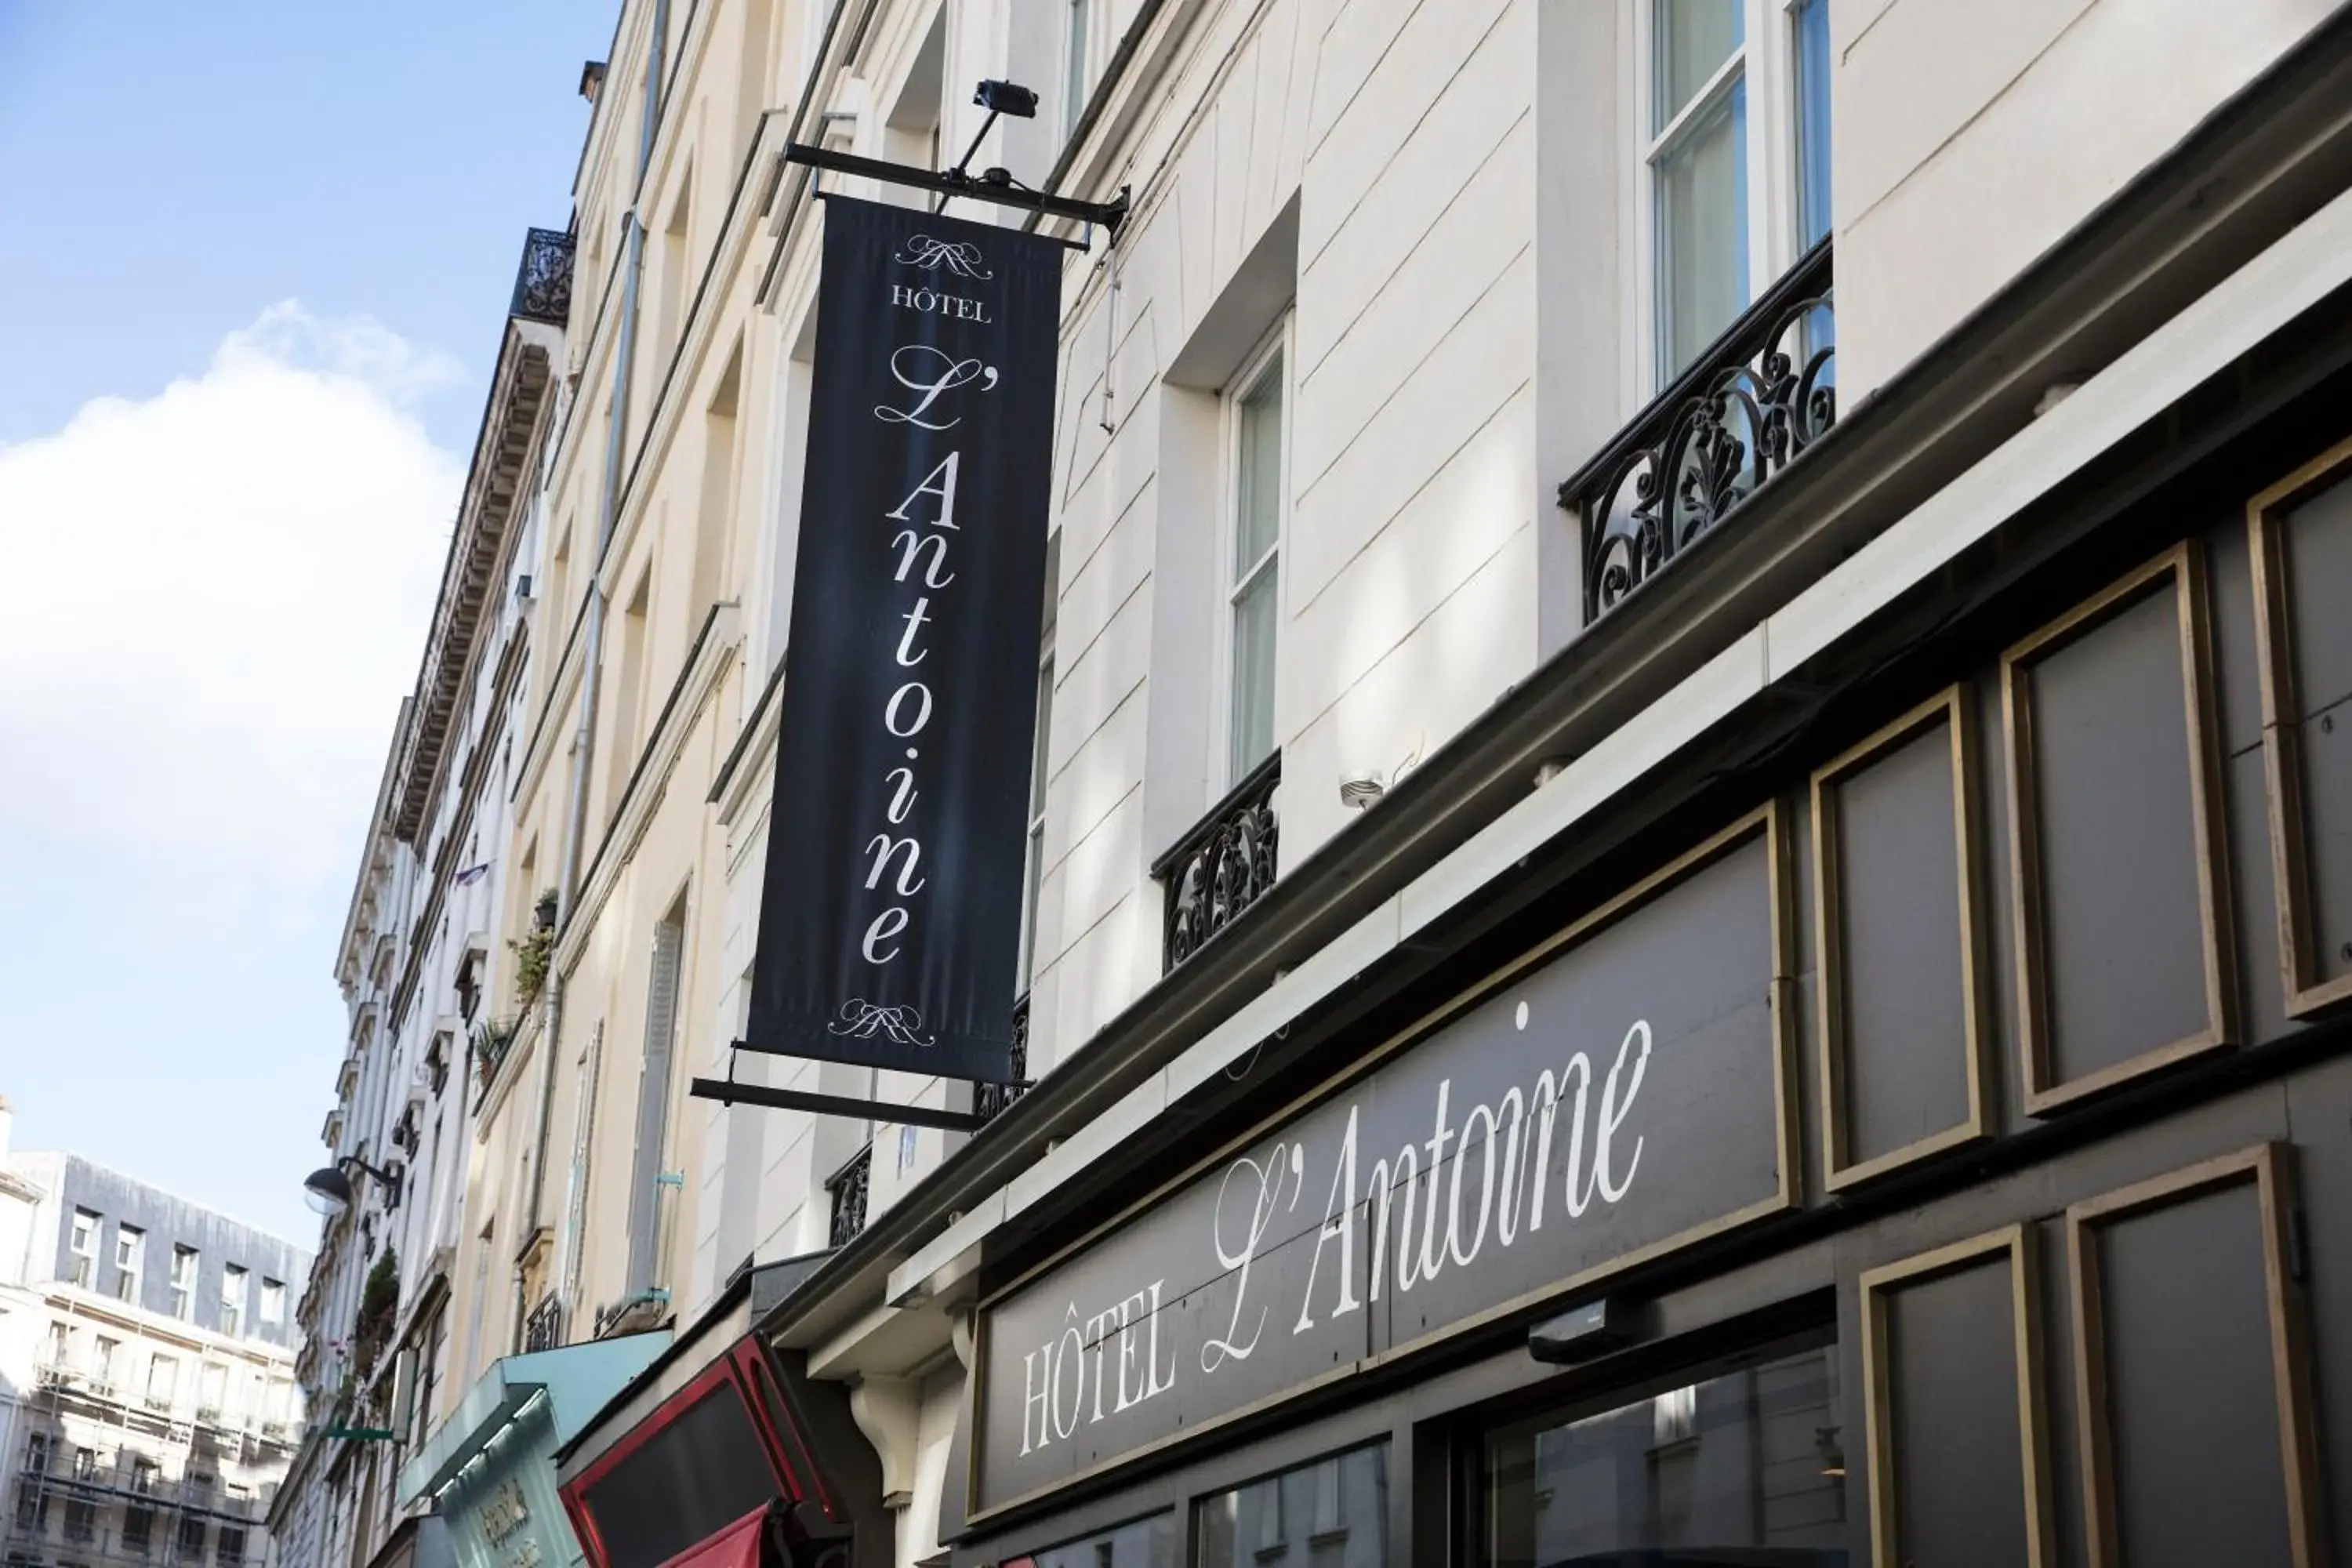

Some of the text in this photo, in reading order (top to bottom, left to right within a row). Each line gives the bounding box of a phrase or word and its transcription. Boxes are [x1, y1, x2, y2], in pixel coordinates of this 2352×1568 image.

[891, 285, 993, 324] HÔTEL
[1018, 1001, 1652, 1457] HÔTEL L'Antoine
